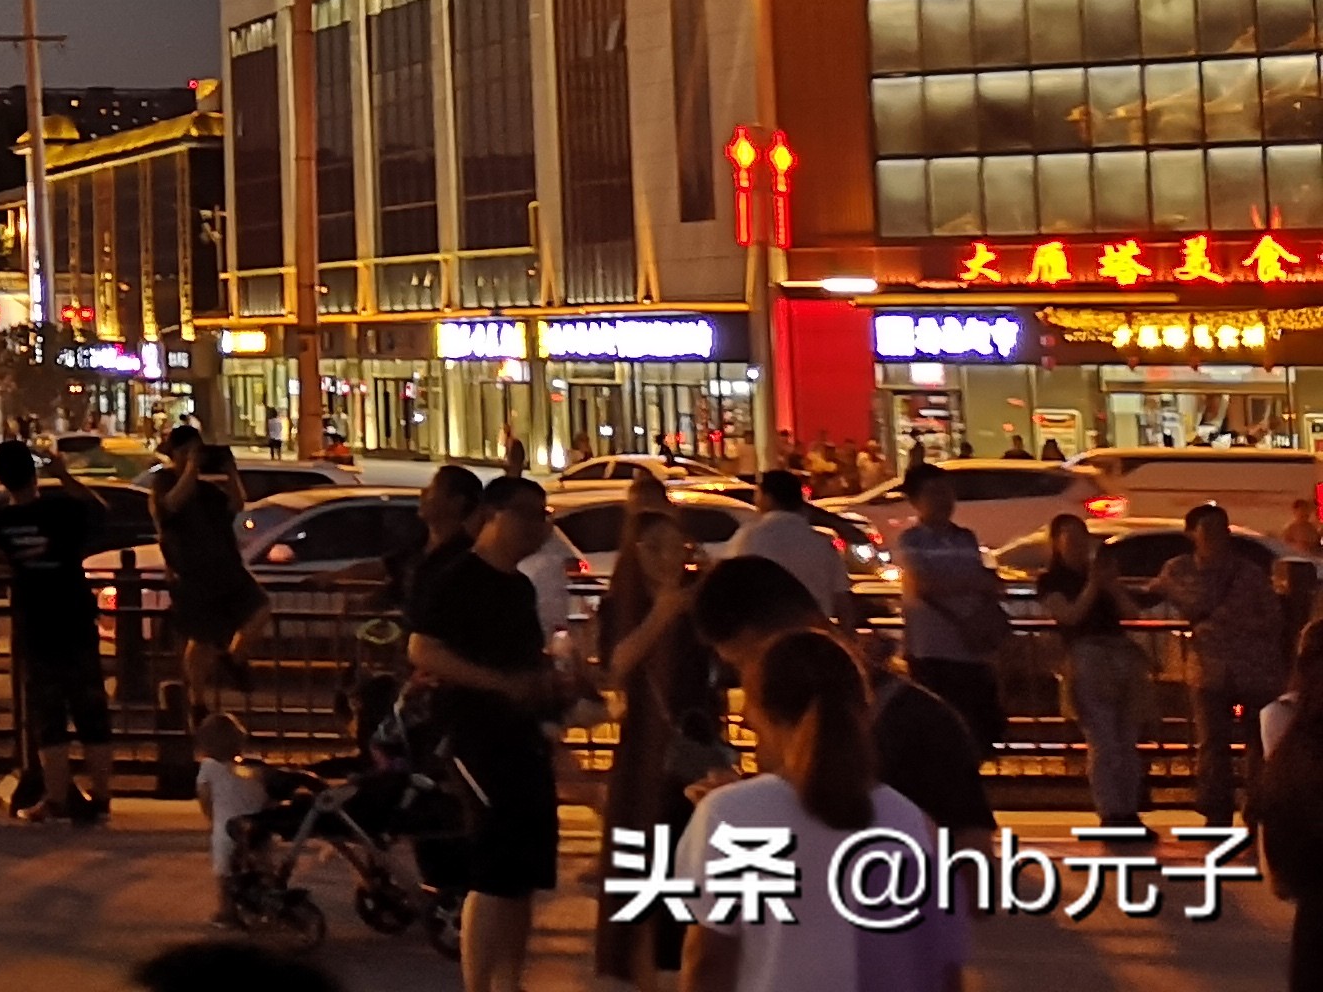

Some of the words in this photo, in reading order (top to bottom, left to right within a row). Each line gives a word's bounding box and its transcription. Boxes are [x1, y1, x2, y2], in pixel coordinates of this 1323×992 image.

[958, 234, 1302, 286] 大雁塔美食
